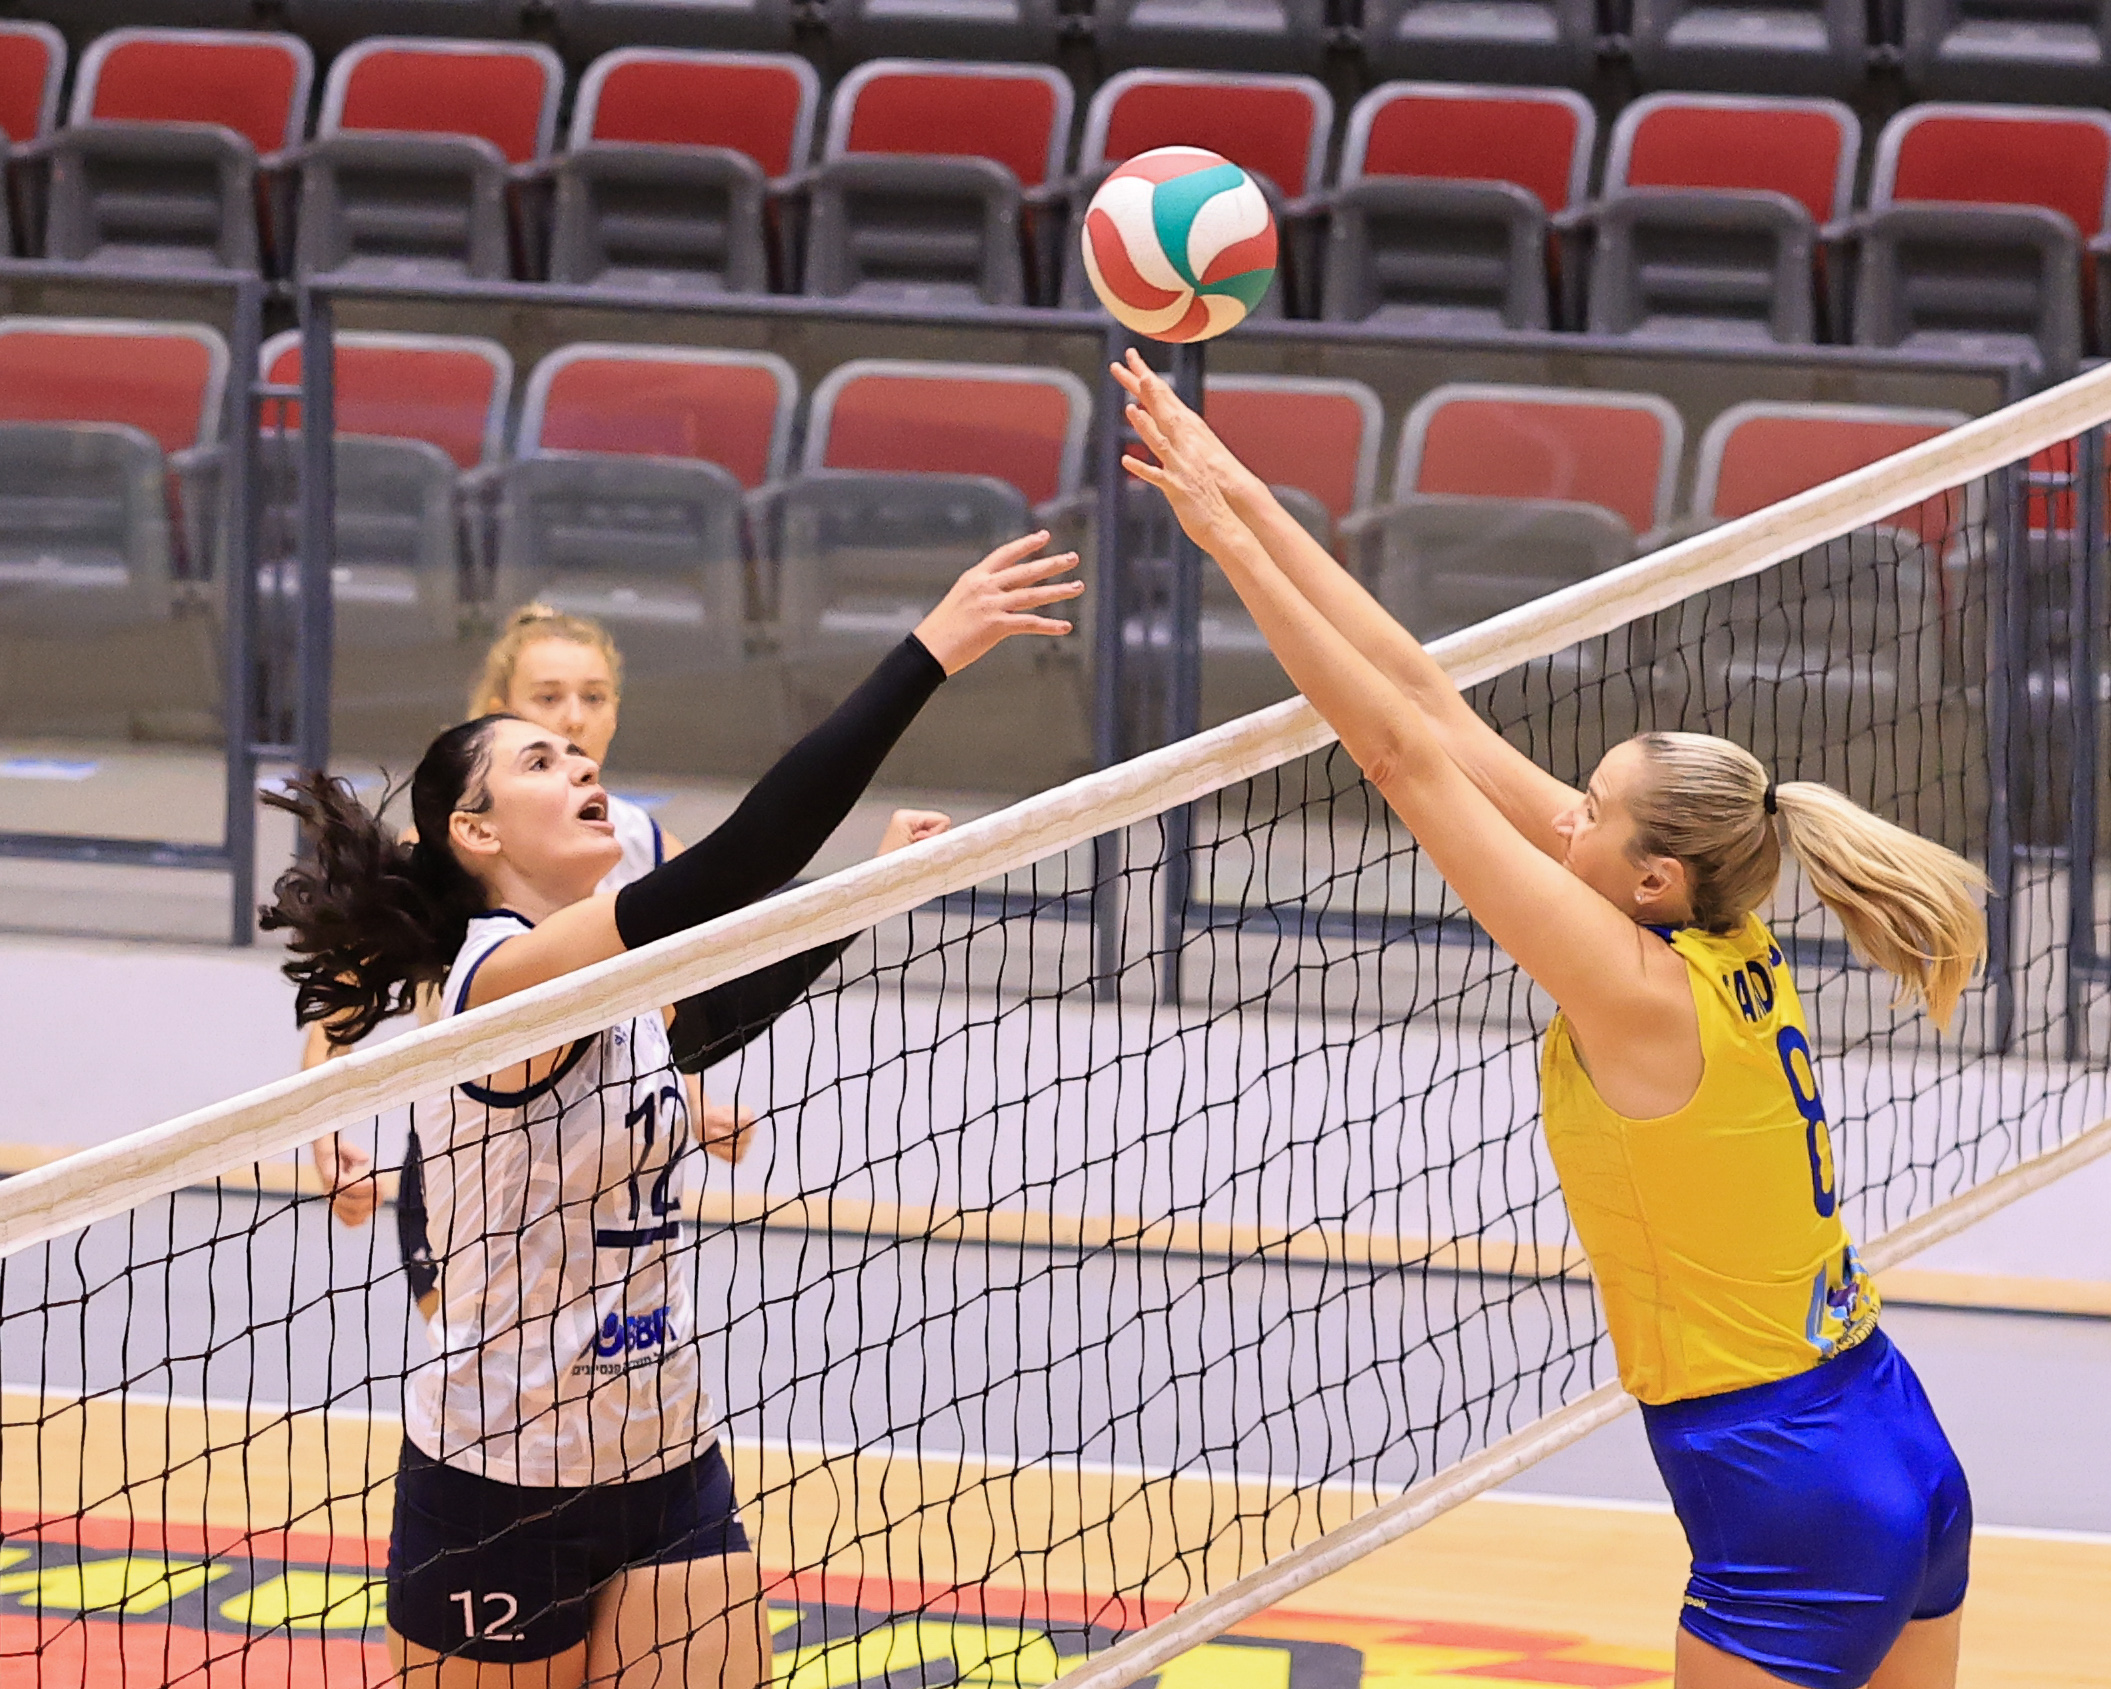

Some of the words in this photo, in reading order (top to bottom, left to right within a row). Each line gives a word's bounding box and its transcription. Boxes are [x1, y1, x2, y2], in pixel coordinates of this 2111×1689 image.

[624, 1085, 689, 1220] 12
[1776, 1024, 1836, 1218] 8
[449, 1589, 526, 1642] 12
